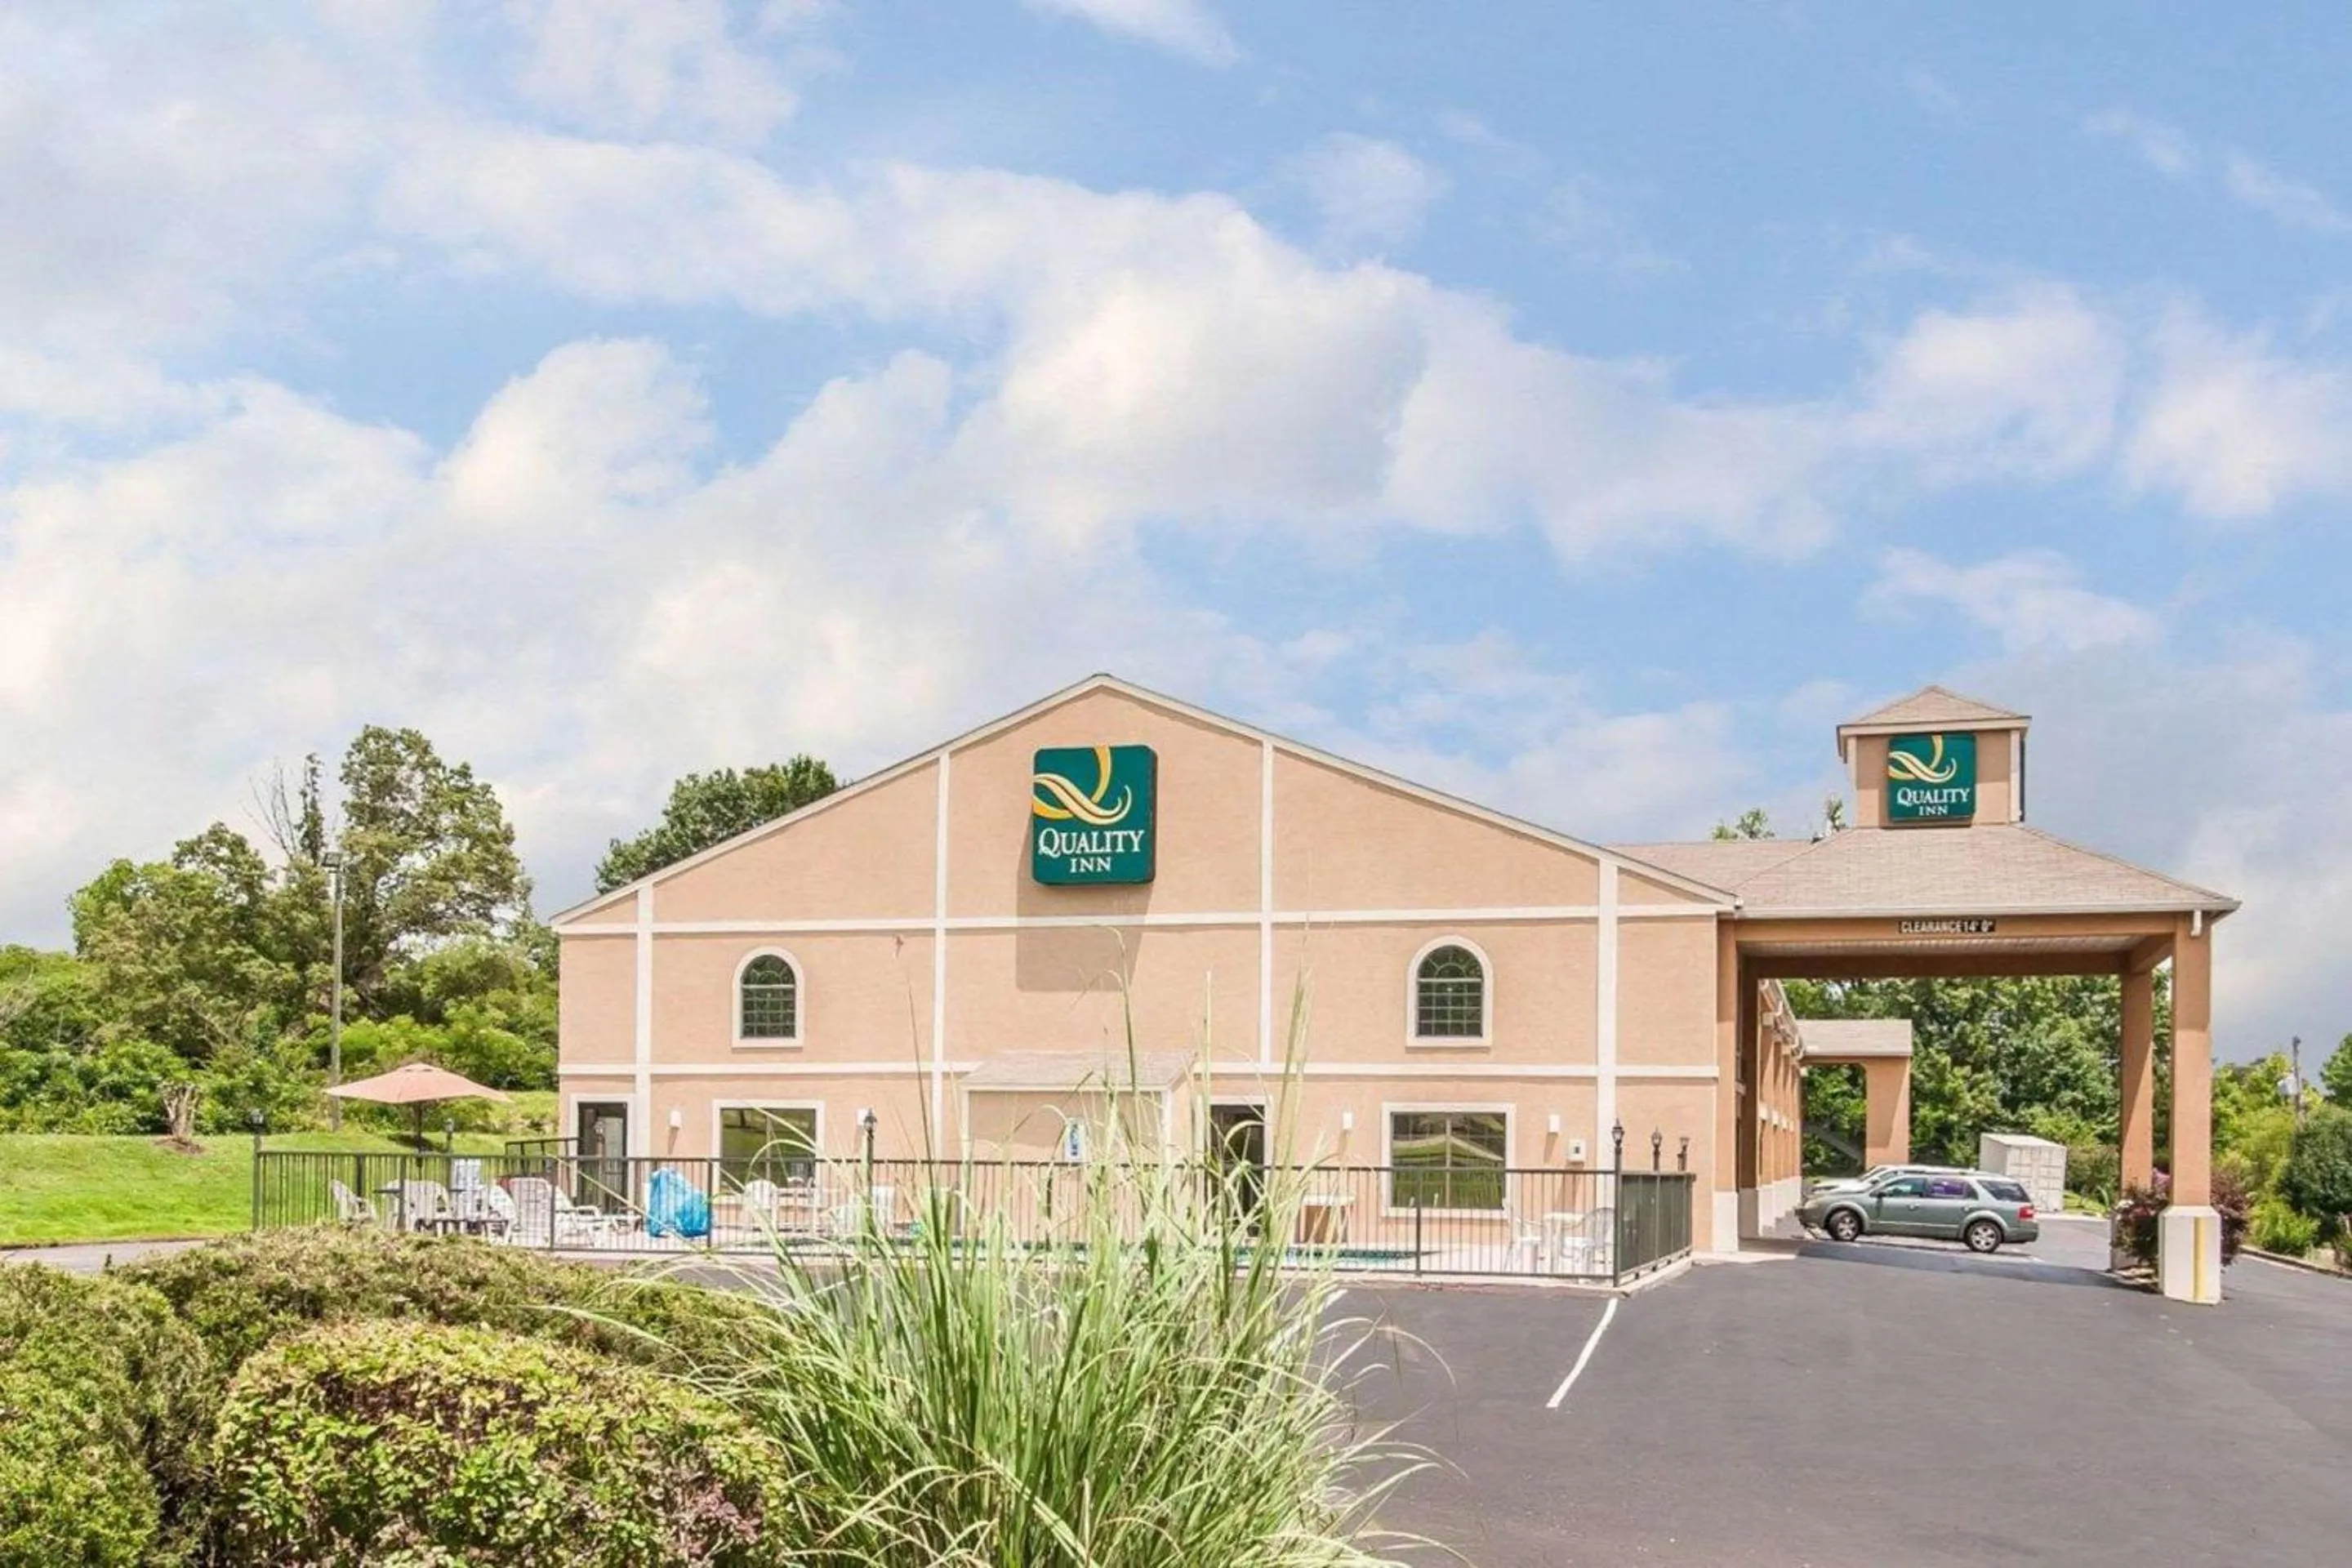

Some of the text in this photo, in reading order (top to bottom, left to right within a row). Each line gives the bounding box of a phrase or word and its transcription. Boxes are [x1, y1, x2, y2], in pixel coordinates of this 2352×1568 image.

[1896, 786, 1970, 807] QUALITY
[1918, 804, 1948, 816] INN
[1038, 827, 1144, 858] QUALITY
[1070, 856, 1111, 873] INN
[1901, 920, 1962, 933] CLEARANCE
